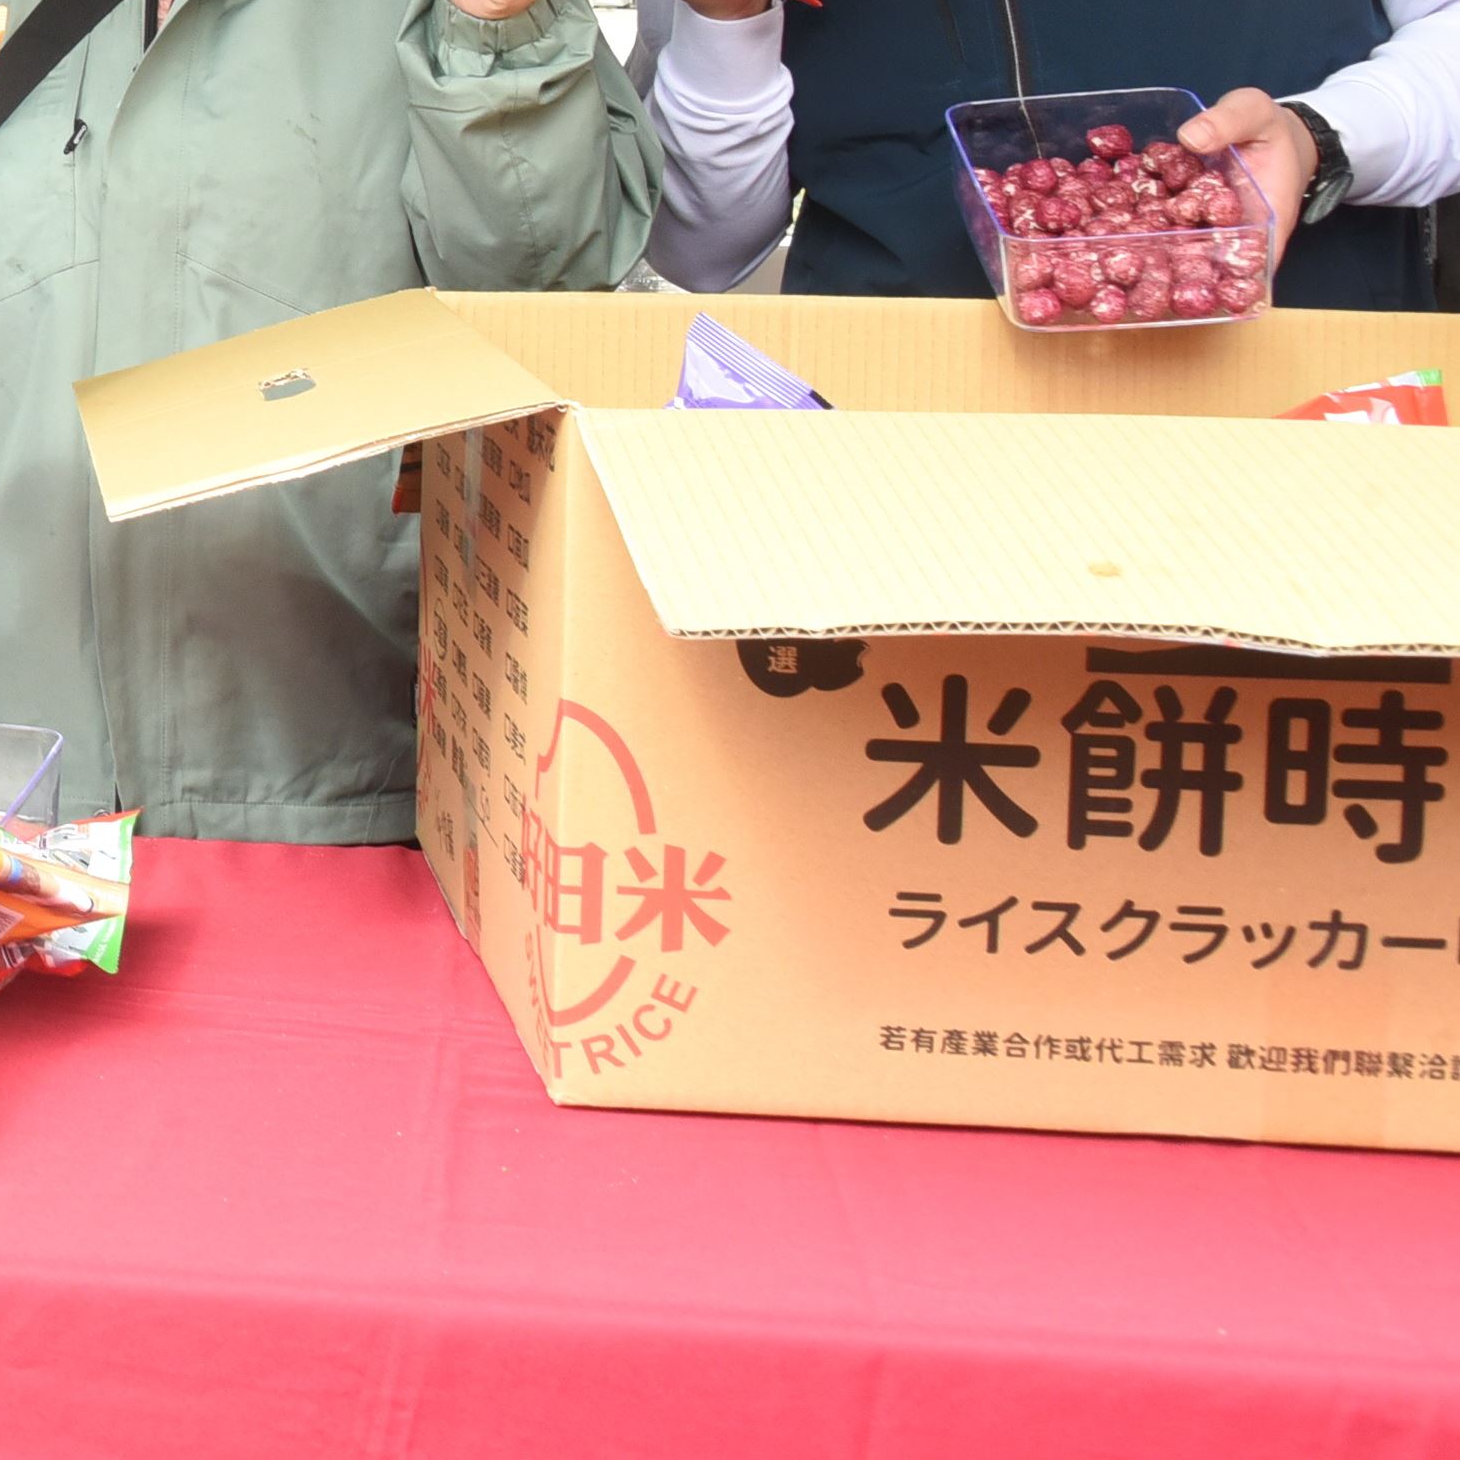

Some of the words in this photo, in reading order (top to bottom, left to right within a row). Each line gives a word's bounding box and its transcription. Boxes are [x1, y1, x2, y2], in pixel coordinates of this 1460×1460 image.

[767, 645, 798, 675] 選
[863, 674, 1449, 864] 米餅時
[522, 791, 732, 953] 好田米
[888, 891, 1460, 971] ライスクラッカー
[878, 1024, 1217, 1070] 若有產業合作或代工需求
